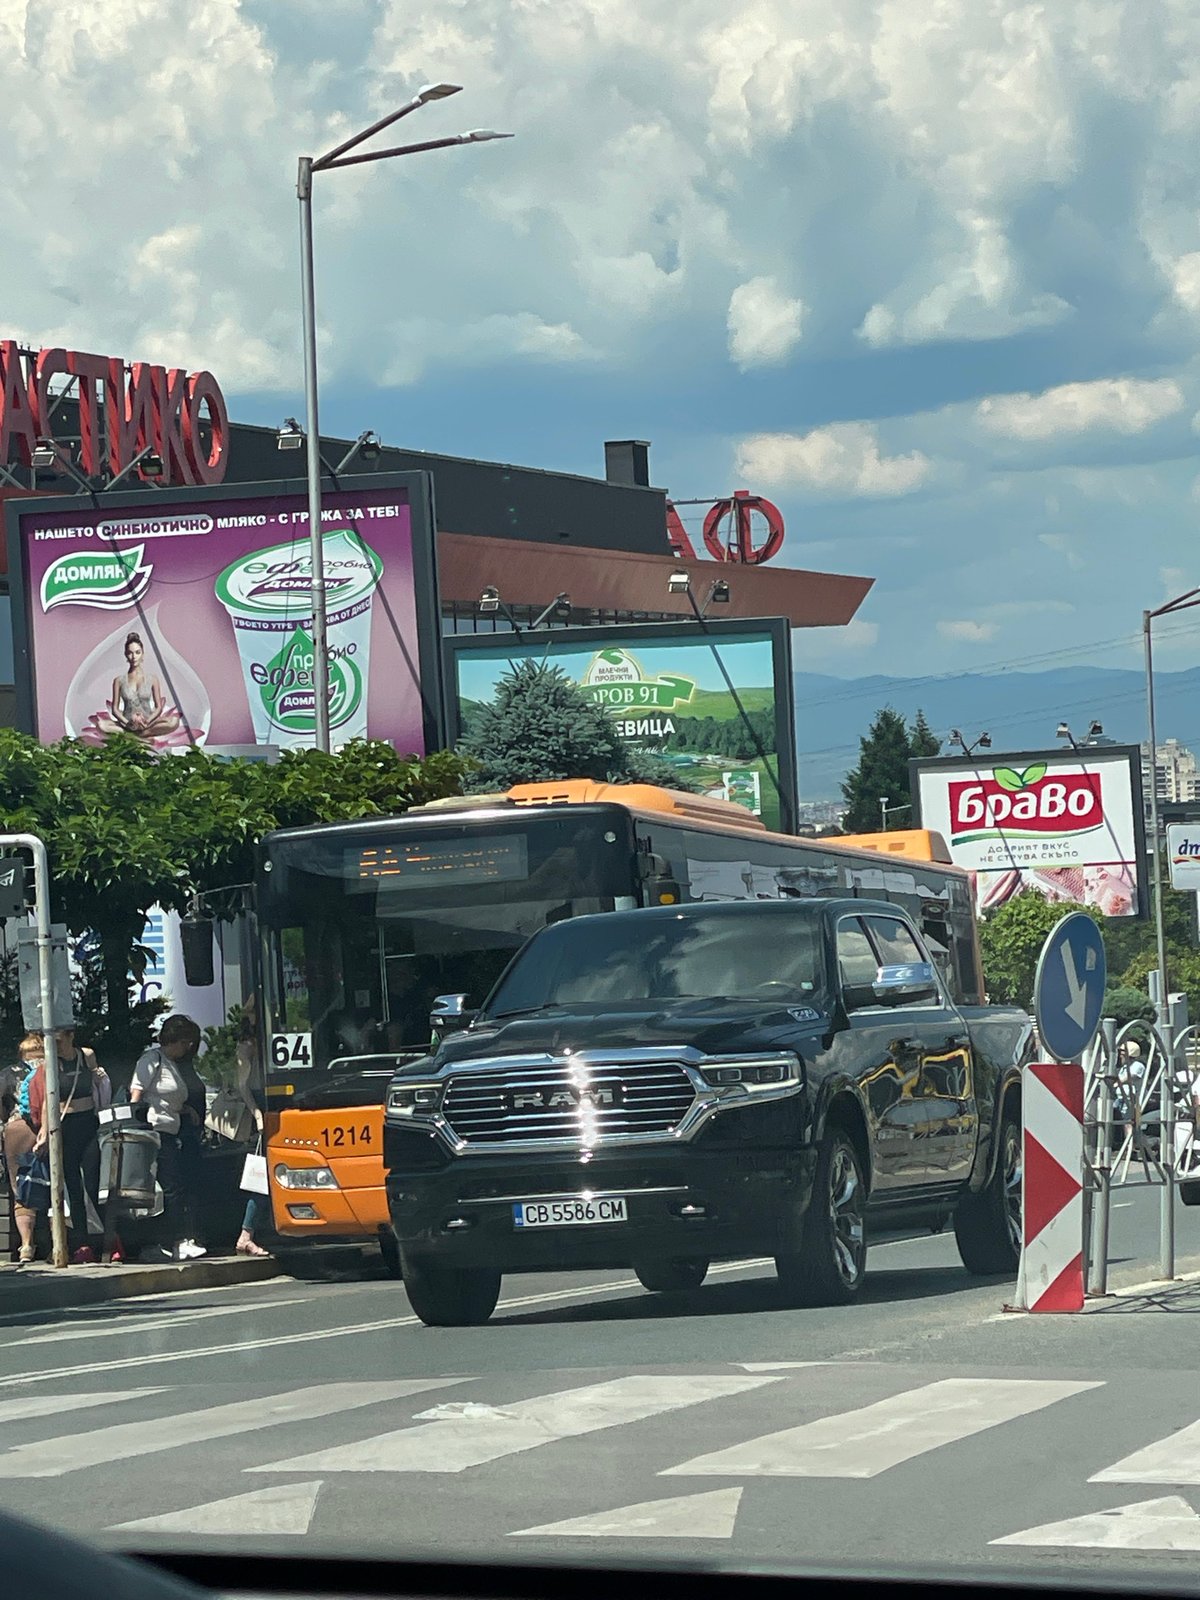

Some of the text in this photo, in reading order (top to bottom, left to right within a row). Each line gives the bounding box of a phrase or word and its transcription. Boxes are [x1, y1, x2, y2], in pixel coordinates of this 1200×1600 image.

[34, 526, 94, 540] НАШЕТО
[101, 519, 210, 537] СИНБИОТИЧНО
[217, 514, 266, 529] МЛЯКО
[278, 512, 288, 524] С
[292, 510, 342, 524] ГРЖА
[345, 508, 365, 520] ЗА
[367, 505, 399, 518] ТЕБ!
[54, 564, 126, 584] ДОМЛЯН
[341, 609, 352, 619] ОТ
[293, 642, 357, 671] прбио
[594, 674, 633, 682] ПРОДУКТИ
[640, 686, 659, 704] 91
[1042, 841, 1070, 850] ВКУС
[980, 855, 993, 863] НЕ
[997, 853, 1037, 861] СТРУВА
[271, 1035, 310, 1066] 64
[513, 1088, 614, 1108] RAM
[321, 1125, 372, 1147] 1214
[552, 1203, 596, 1221] 5586
